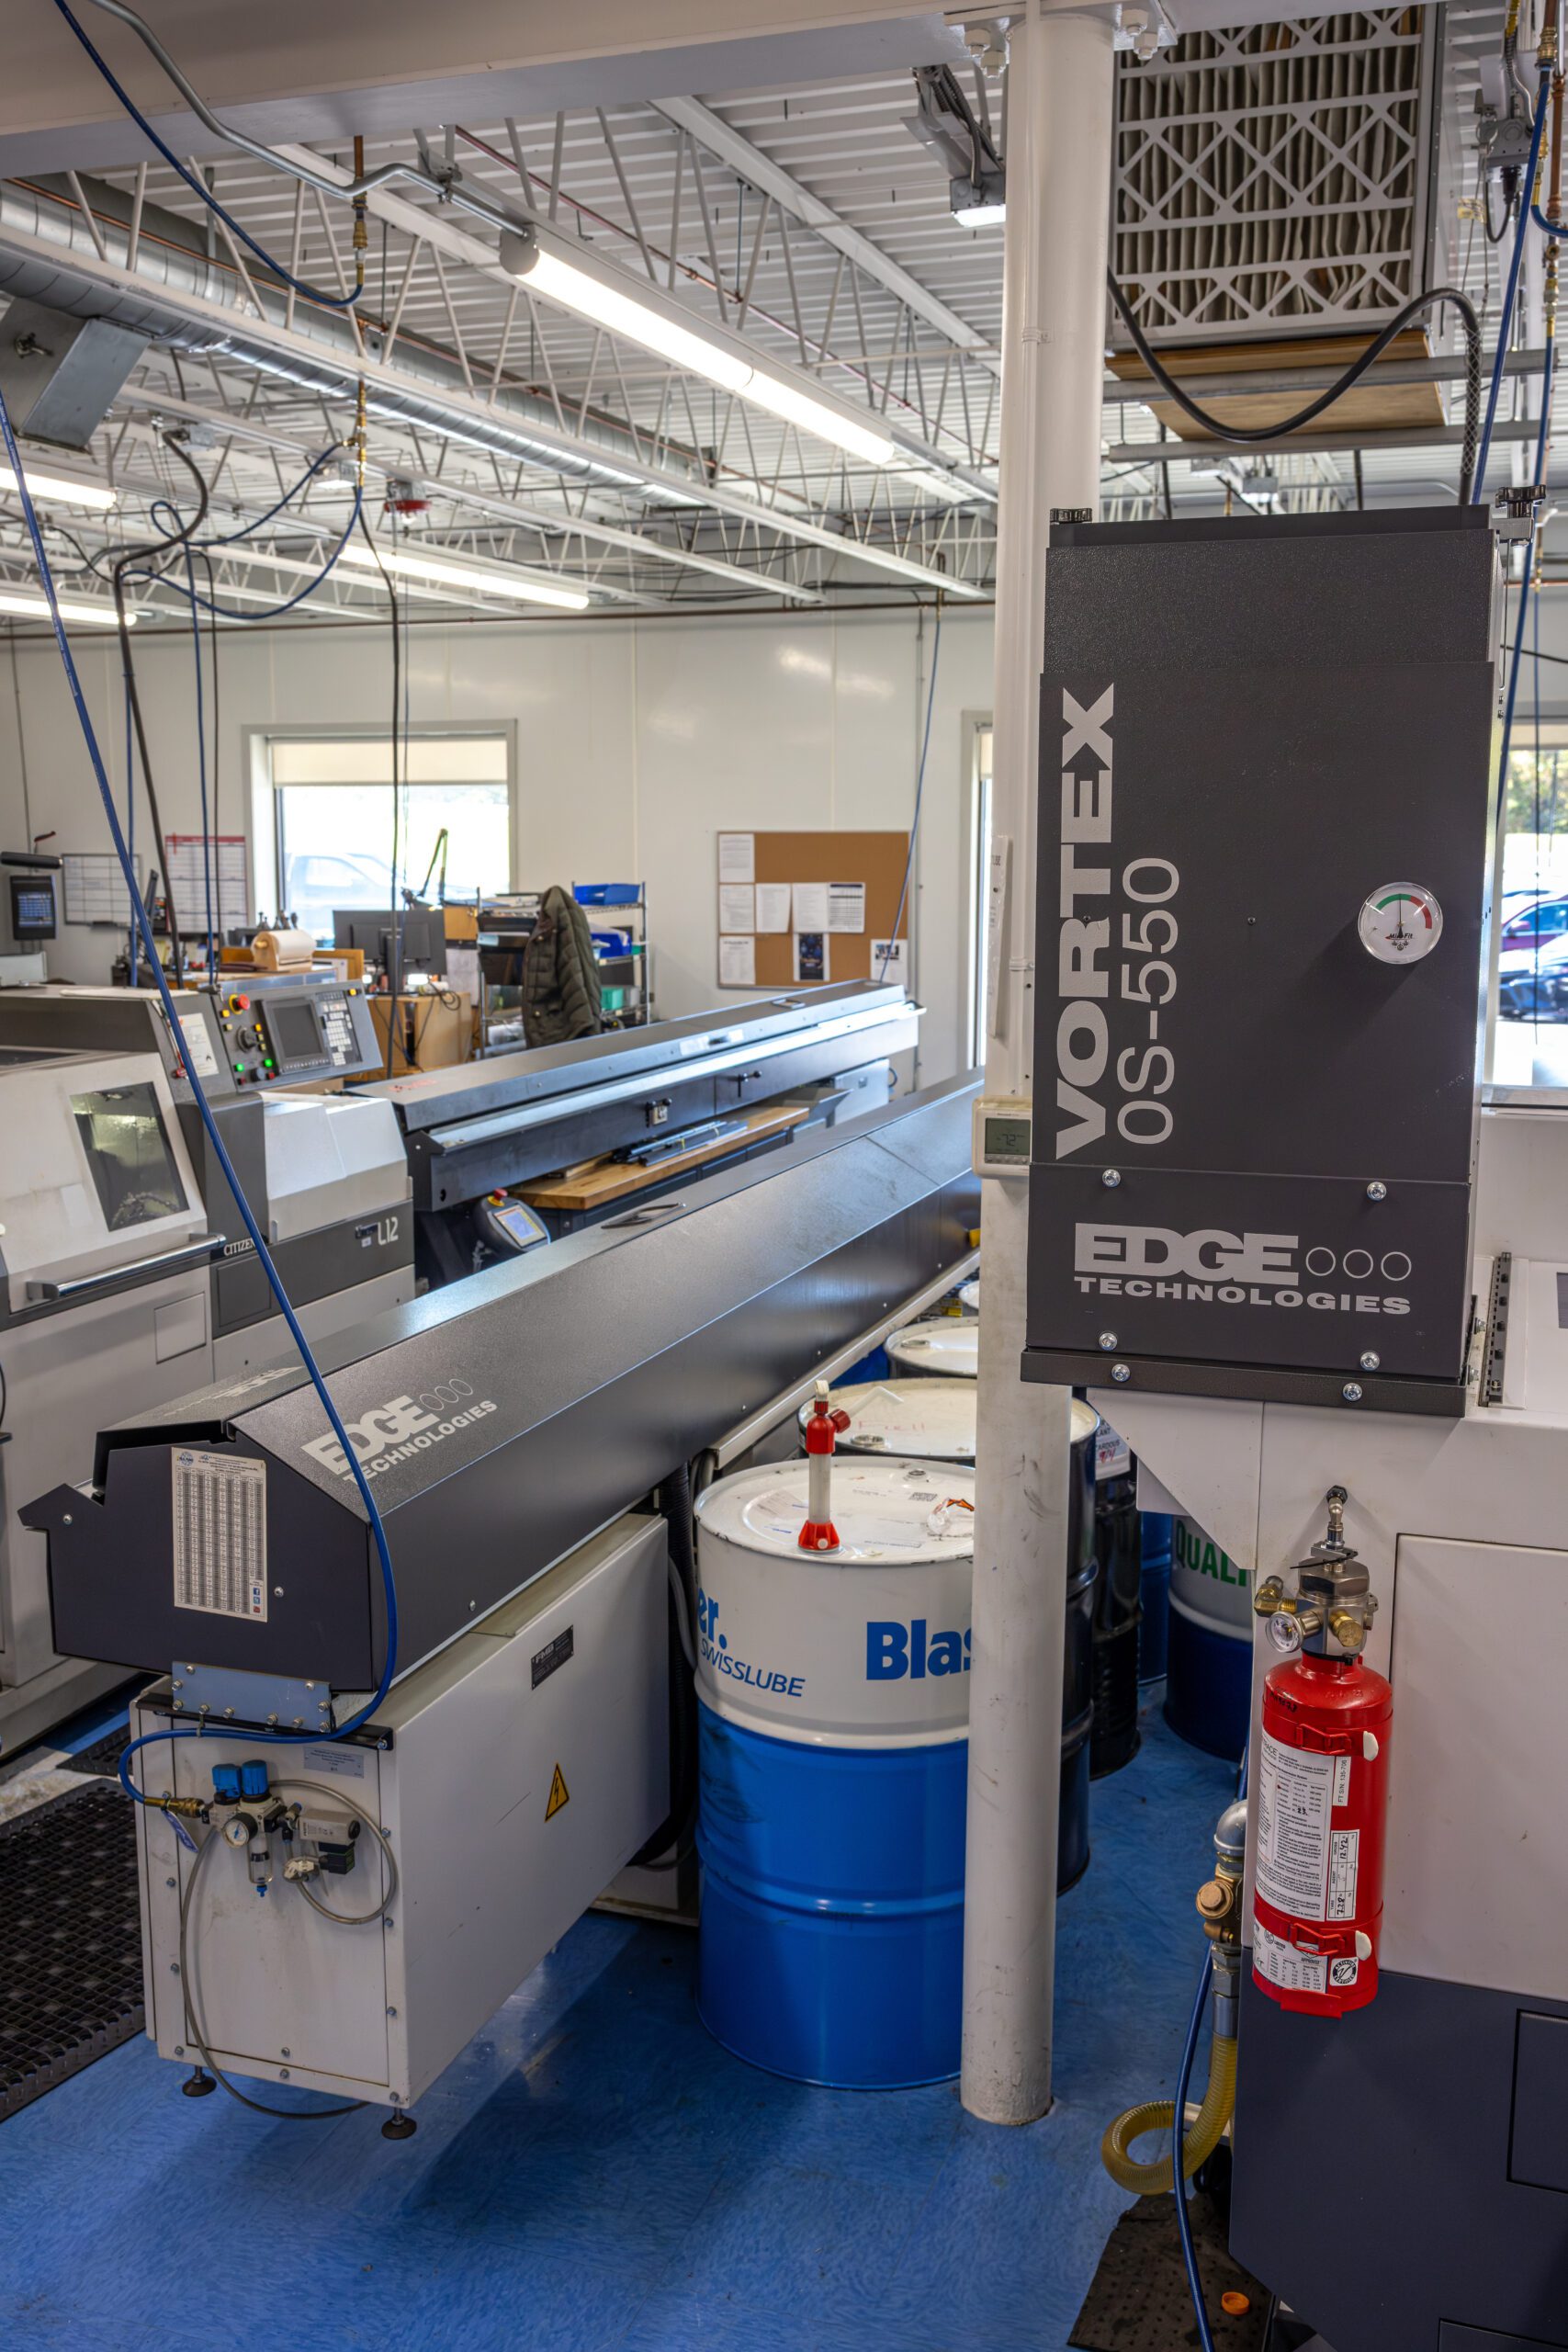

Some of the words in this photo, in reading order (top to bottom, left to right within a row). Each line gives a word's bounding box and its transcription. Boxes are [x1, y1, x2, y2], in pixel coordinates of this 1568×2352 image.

[1056, 683, 1114, 1160] VORTEX
[378, 1216, 400, 1247] L12
[1075, 1223, 1299, 1285] EDGE
[1074, 1276, 1411, 1315] TECHNOLOGIES
[300, 1395, 440, 1476] EDGE
[700, 1637, 806, 1697] SWISSLUBE
